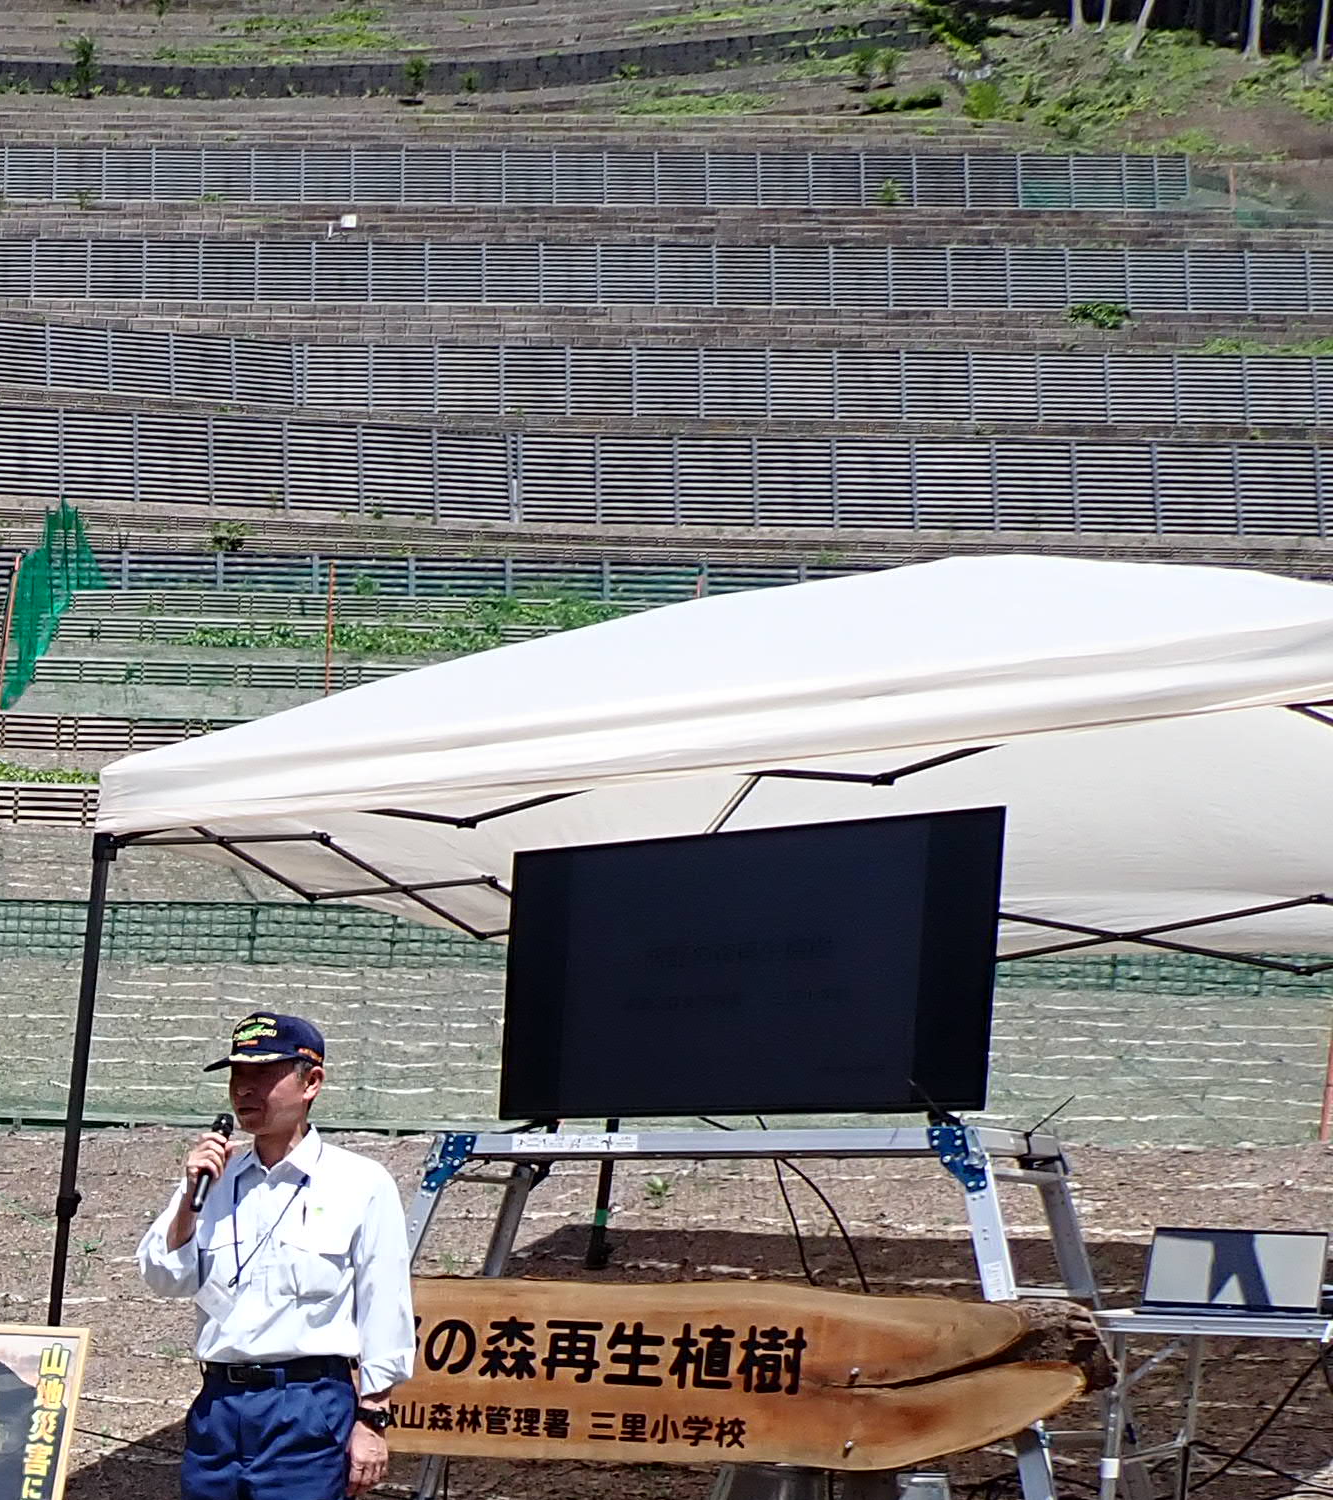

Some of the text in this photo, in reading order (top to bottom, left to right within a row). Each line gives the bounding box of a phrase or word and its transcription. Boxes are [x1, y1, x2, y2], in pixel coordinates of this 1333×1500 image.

[414, 1315, 808, 1396] の森再生植樹
[587, 1410, 747, 1449] 三里小学校
